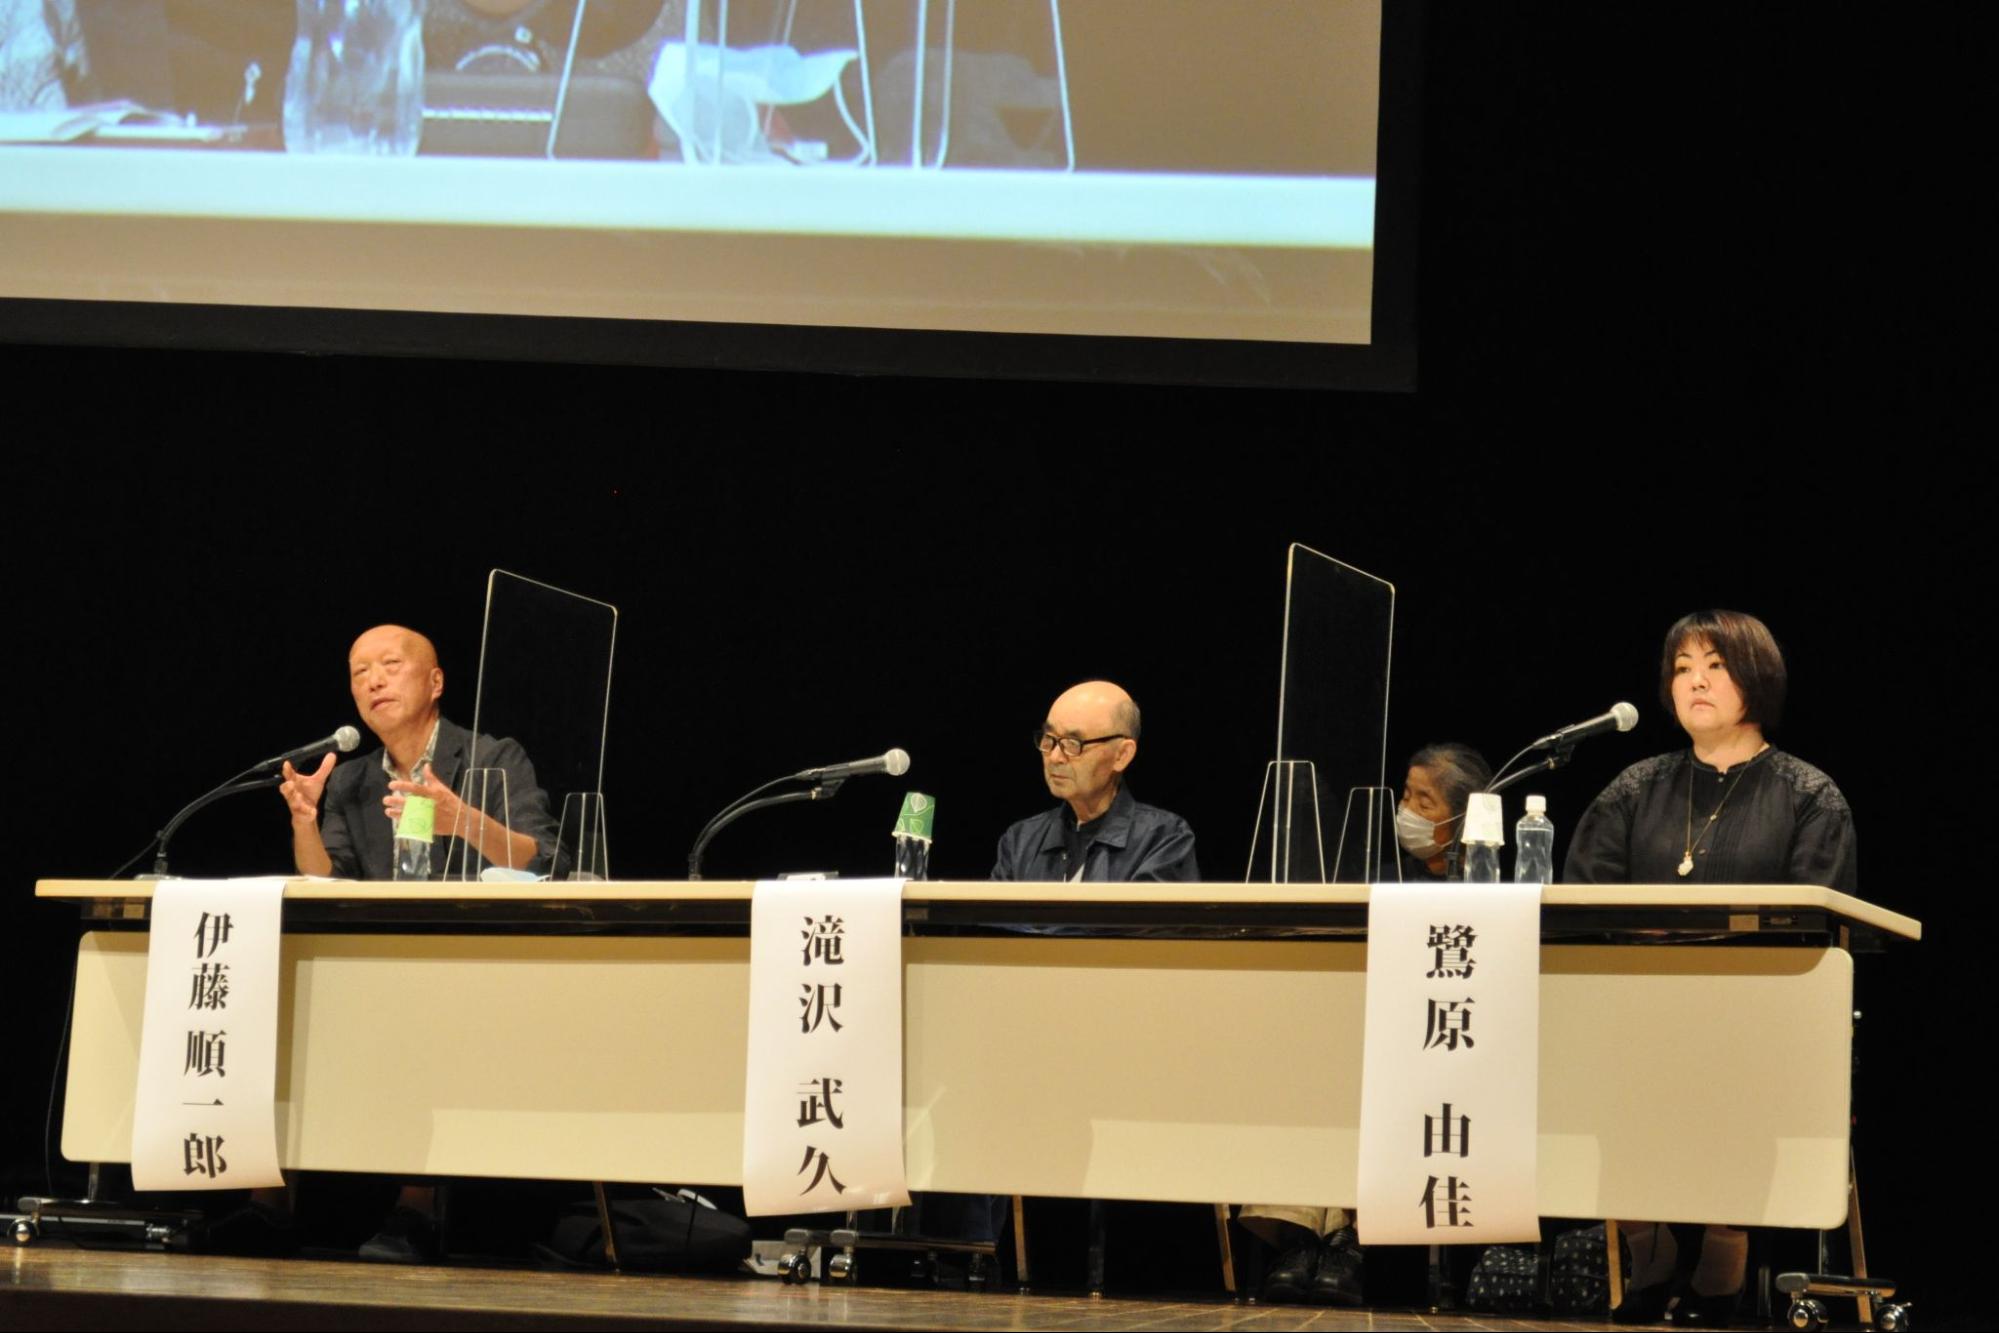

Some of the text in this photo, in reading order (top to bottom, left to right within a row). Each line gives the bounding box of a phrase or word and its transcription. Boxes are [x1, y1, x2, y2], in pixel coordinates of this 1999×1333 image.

[182, 912, 234, 1179] 伊藤 順一郎
[796, 914, 847, 1196] 滝沢 武久
[1418, 924, 1478, 1230] 鷺原 由佳
